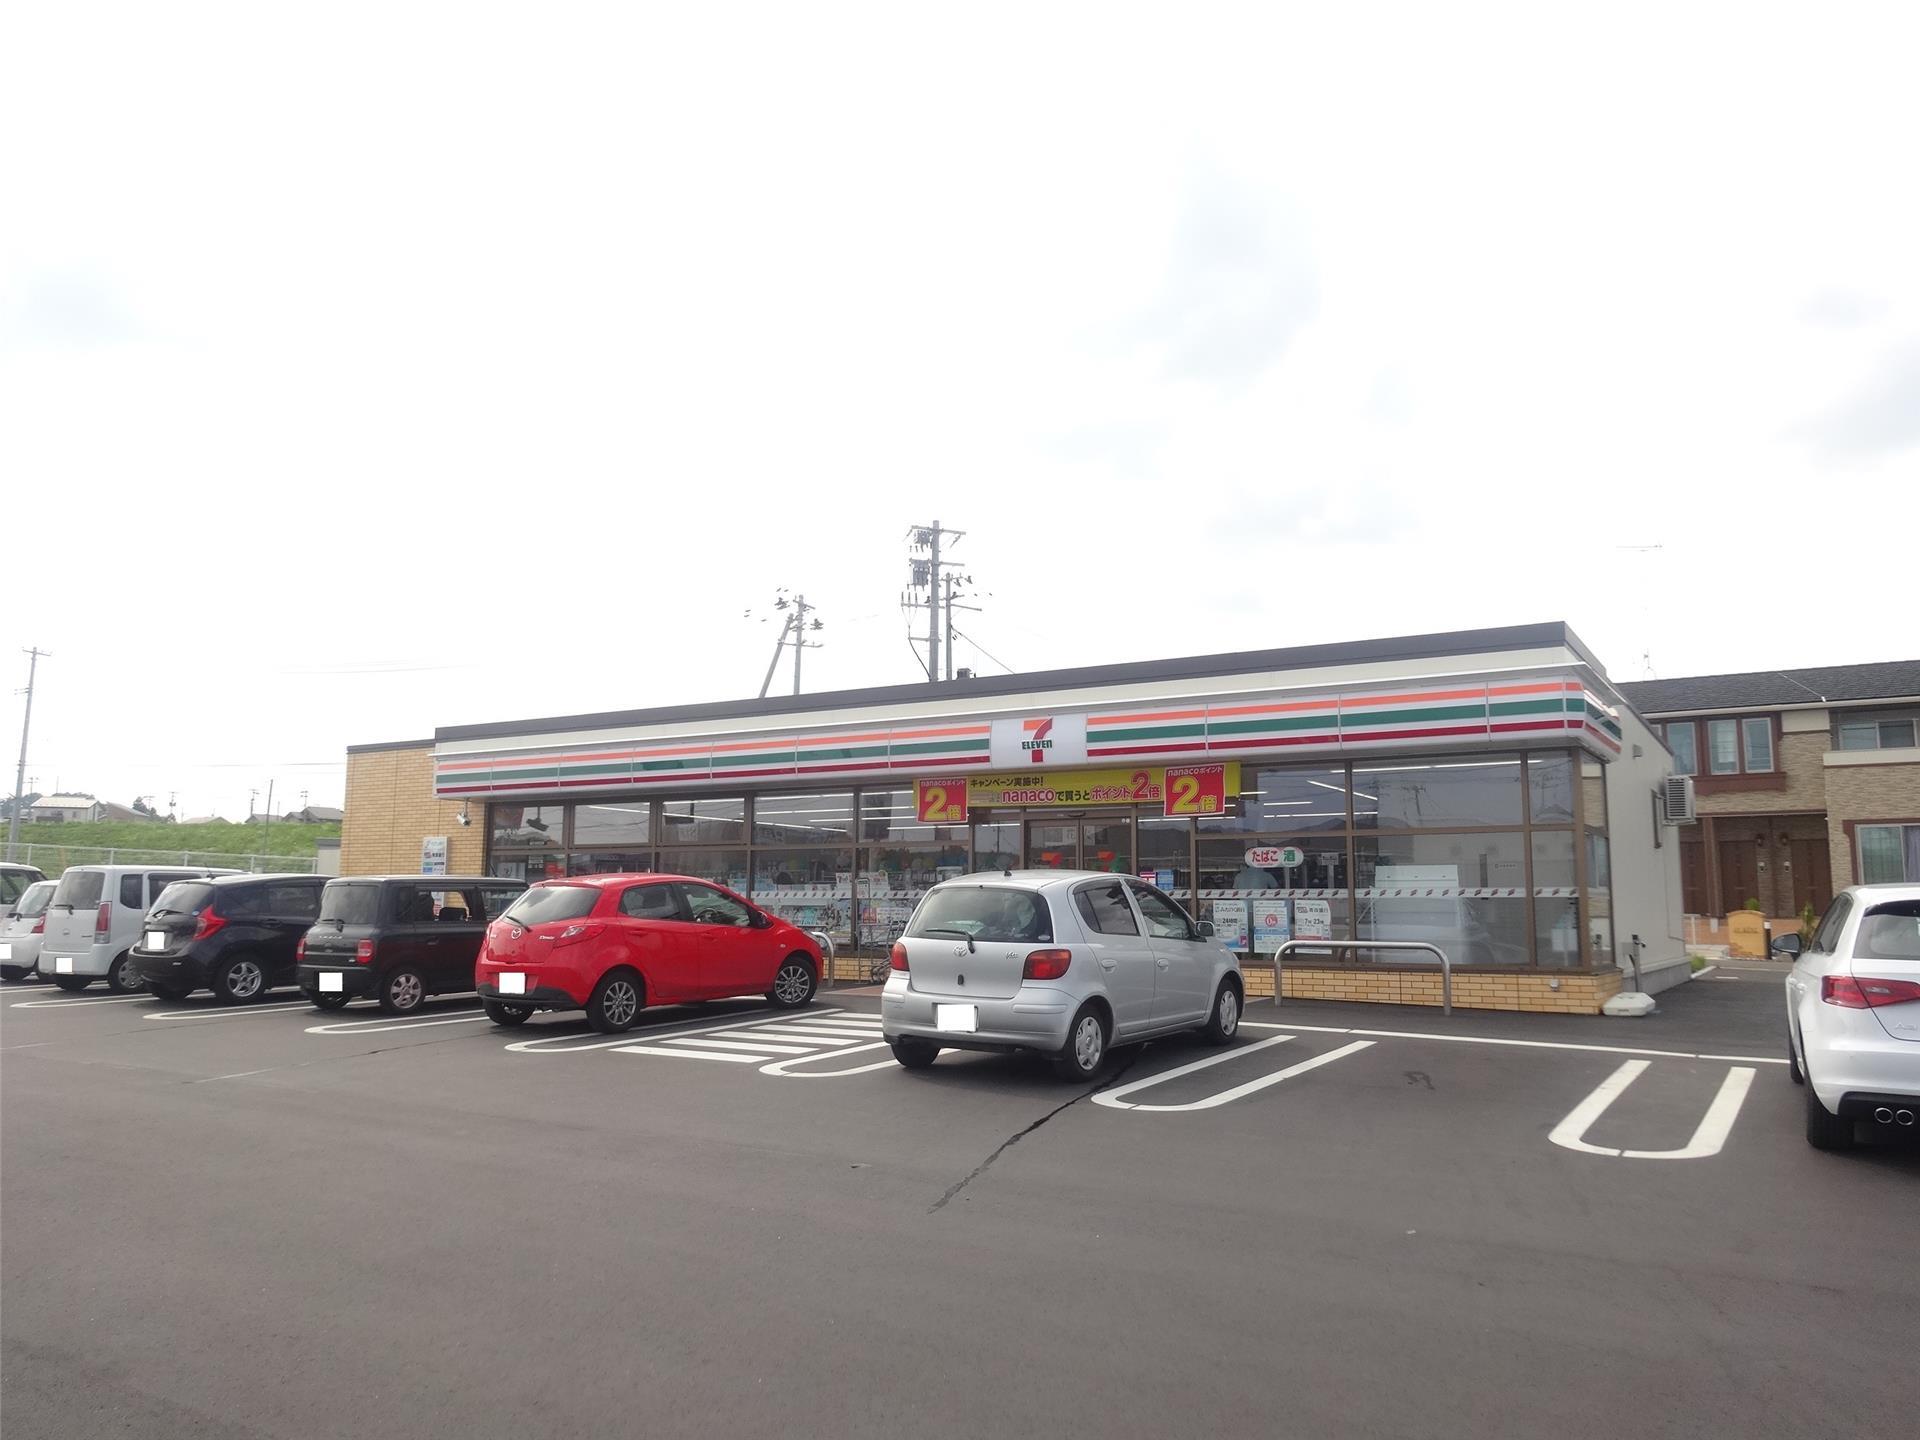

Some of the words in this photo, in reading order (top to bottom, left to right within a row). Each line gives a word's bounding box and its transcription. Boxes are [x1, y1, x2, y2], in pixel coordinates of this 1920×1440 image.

[1022, 716, 1053, 763] 7
[1252, 849, 1278, 862] たばこ
[1283, 849, 1296, 862] 酒
